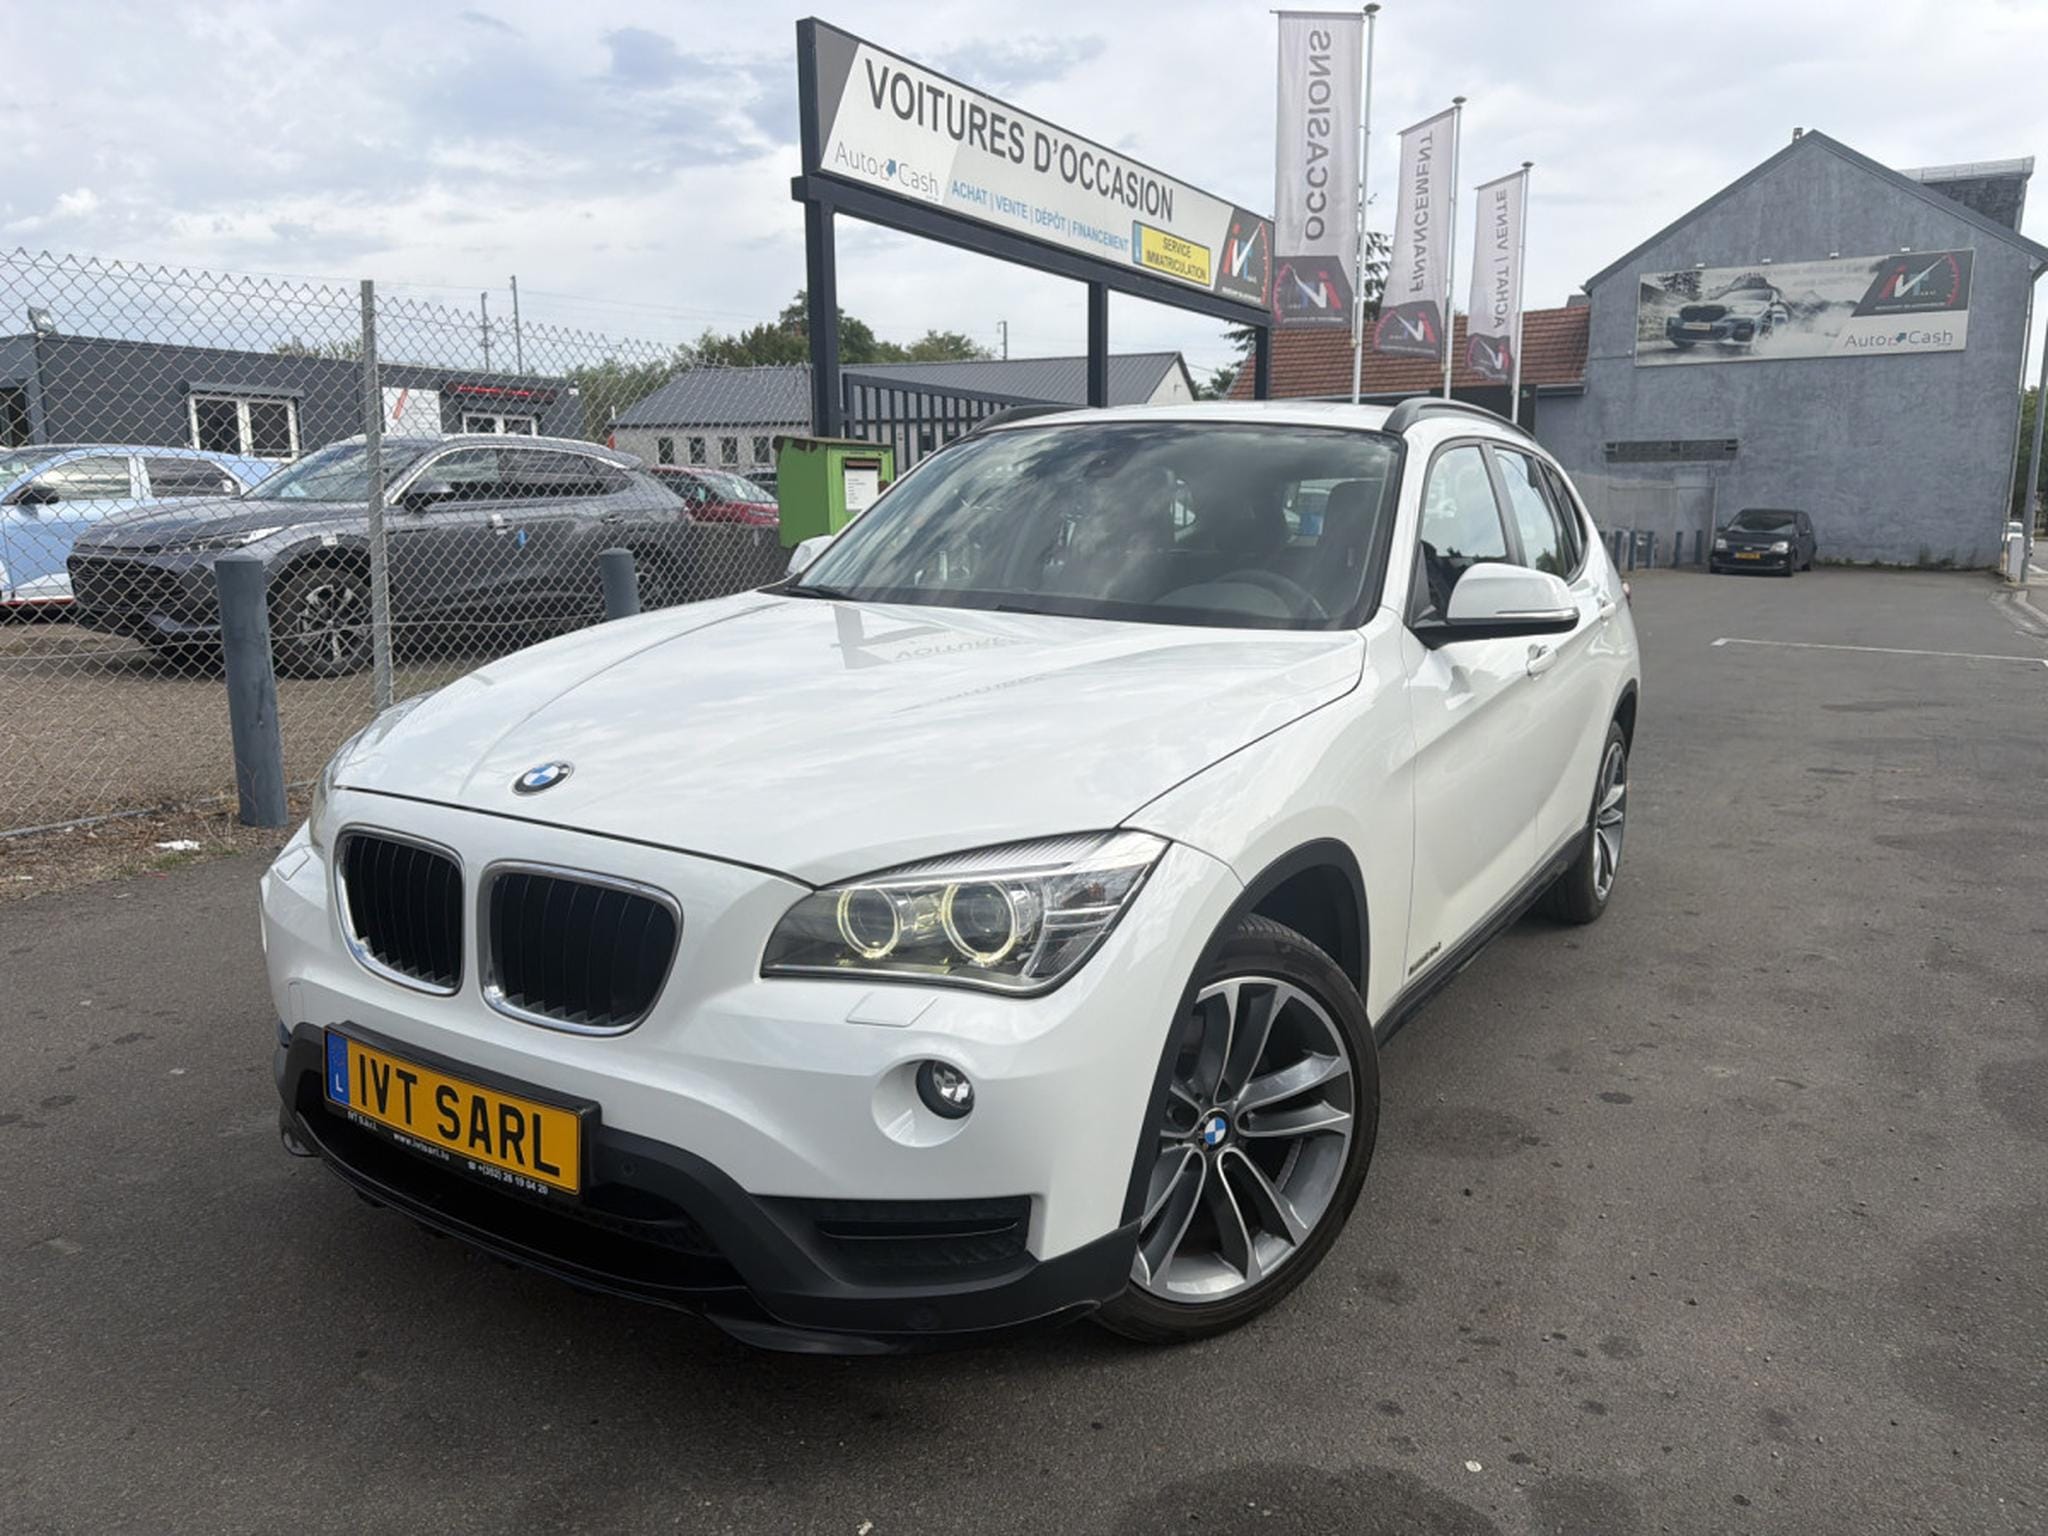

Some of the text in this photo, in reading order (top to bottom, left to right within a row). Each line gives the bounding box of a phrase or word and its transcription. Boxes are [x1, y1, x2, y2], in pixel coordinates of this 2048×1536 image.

[834, 140, 939, 196] Auto Cash
[865, 57, 1173, 223] VOITURES D'OCCASION
[952, 180, 988, 205] ACHAT
[996, 195, 1027, 219] VENTE
[1035, 208, 1066, 232] DÉPÔT
[1072, 220, 1128, 252] FINANCEMENT
[1146, 249, 1207, 281] IMMATRICULATION
[1163, 237, 1192, 259] SERVICE
[1844, 330, 1953, 347] Auto Cash
[335, 1054, 560, 1178] L IVT SARL
